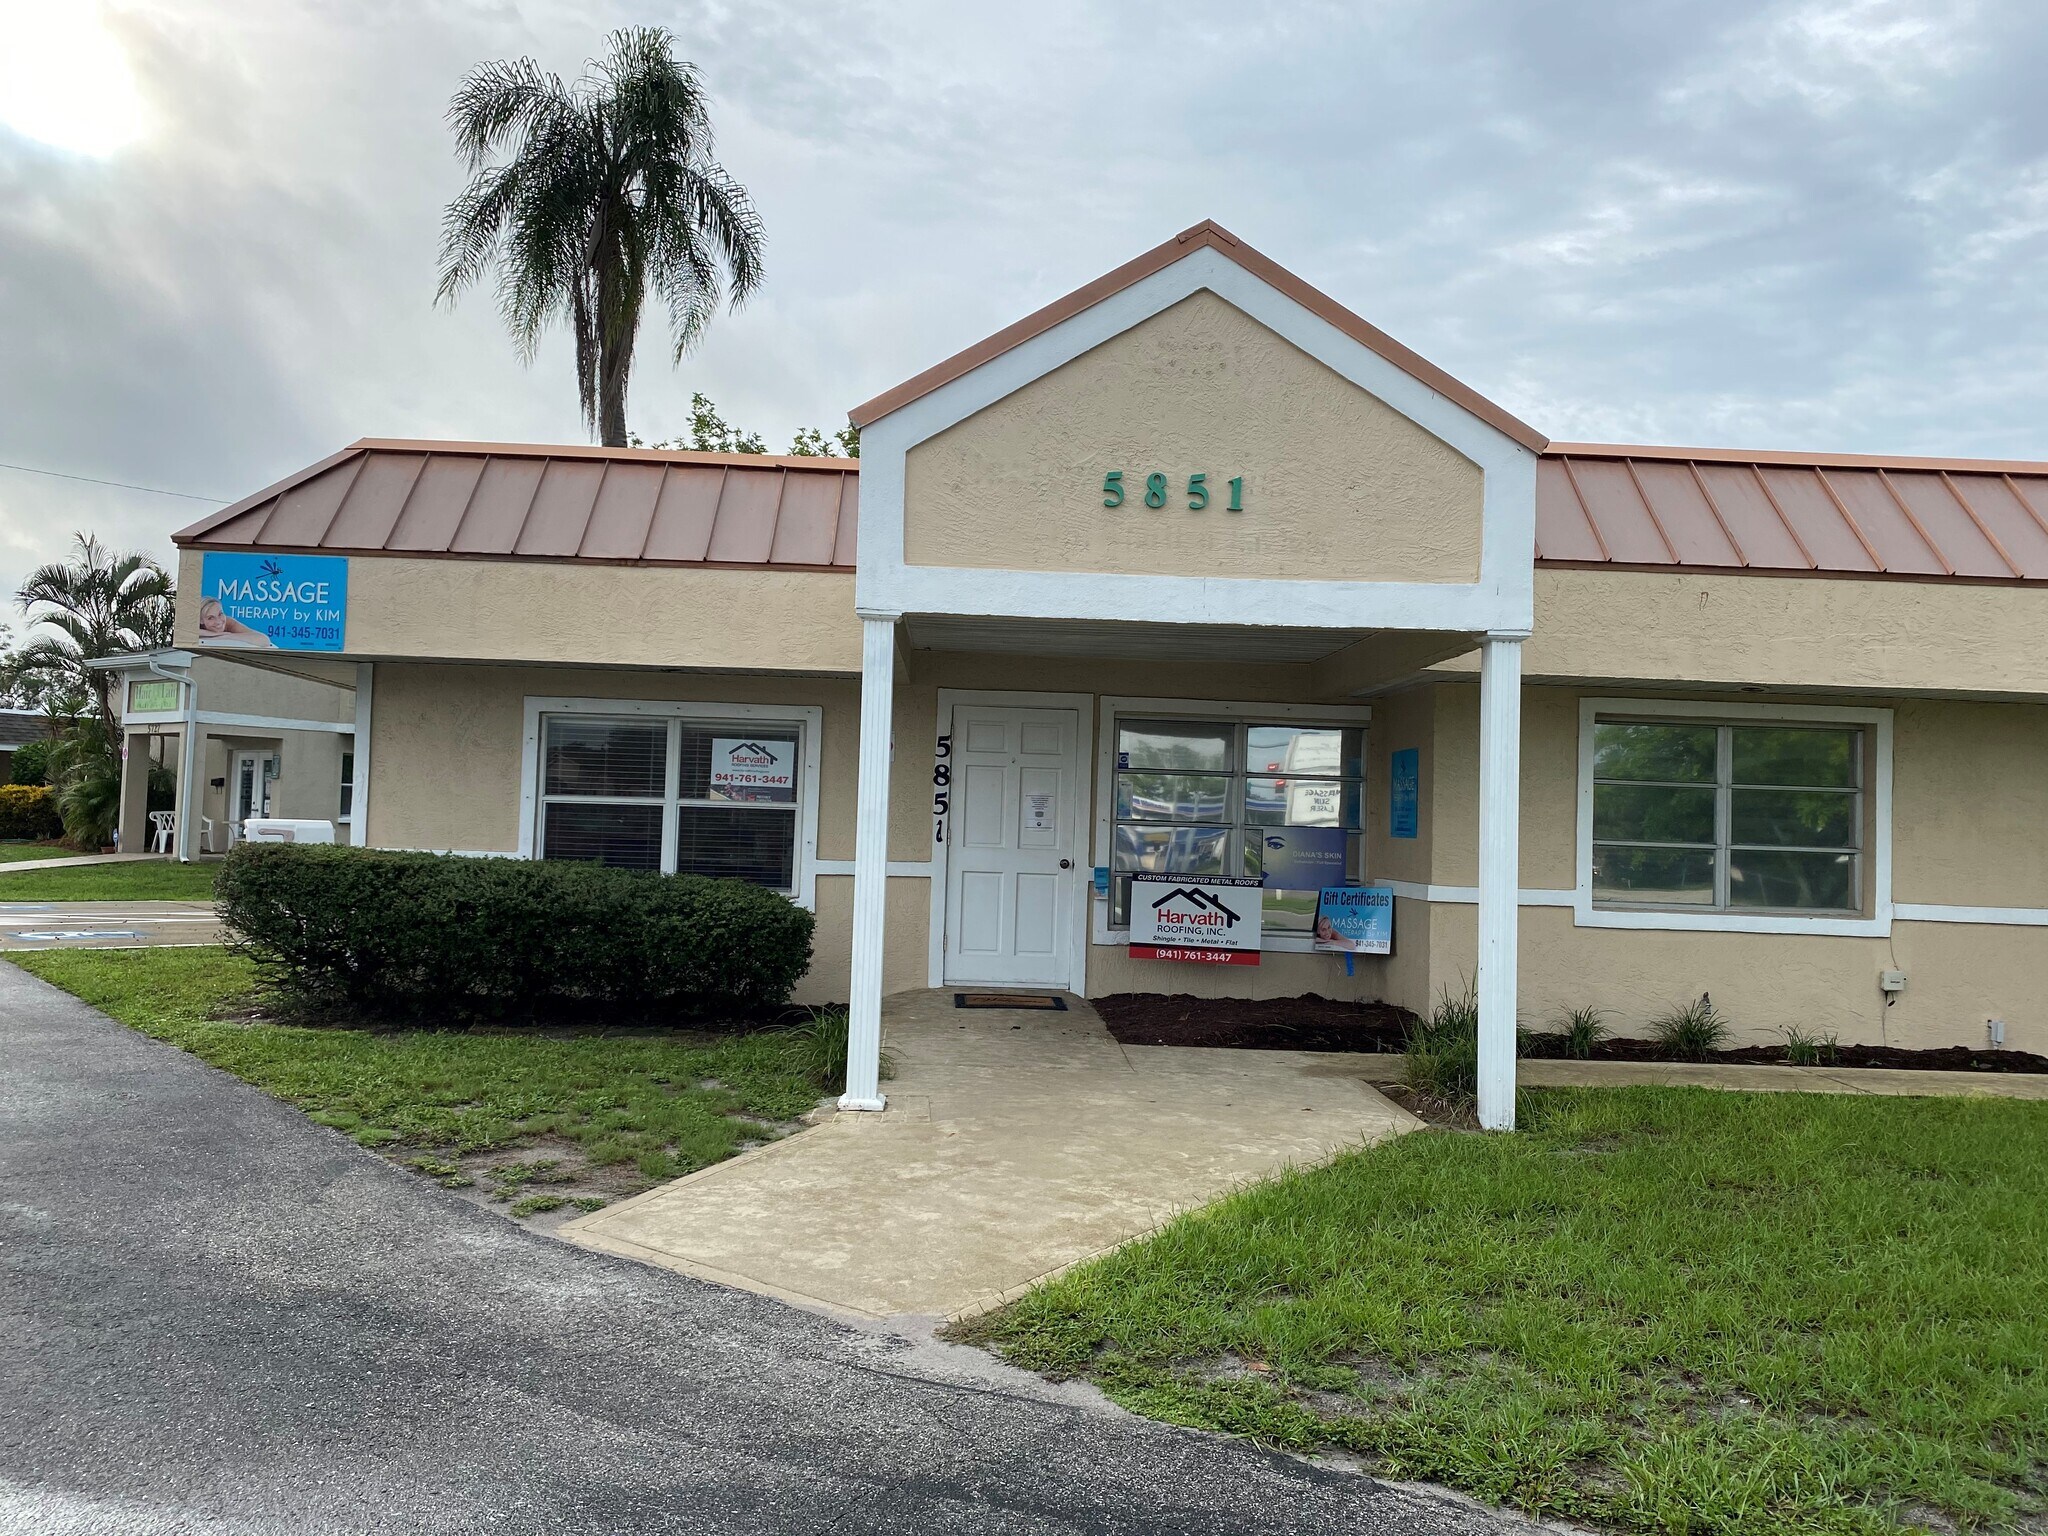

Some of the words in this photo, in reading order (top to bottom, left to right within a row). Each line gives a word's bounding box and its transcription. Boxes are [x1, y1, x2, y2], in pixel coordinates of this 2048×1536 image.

[1103, 470, 1244, 511] 5851
[218, 578, 330, 604] MASSAGE
[230, 605, 289, 620] THERAPY
[294, 608, 310, 622] by
[316, 609, 340, 622] KIM
[267, 625, 340, 640] 941-345-7031
[732, 755, 769, 764] Harvath
[715, 773, 789, 784] 941-761-3447
[933, 735, 952, 842] 5851
[1168, 876, 1210, 884] FABRICATED
[1324, 891, 1338, 905] Gift
[1341, 892, 1389, 906] Certificates
[1157, 909, 1224, 926] Harvath
[1332, 918, 1378, 930] MASSAGE
[1157, 925, 1204, 935] ROOFING,
[1206, 928, 1226, 936] INC.
[1152, 935, 1176, 943] Shingle
[1355, 940, 1388, 948] 941-345-7031
[1156, 949, 1181, 960] (941)
[1184, 951, 1232, 962] 761-3447
